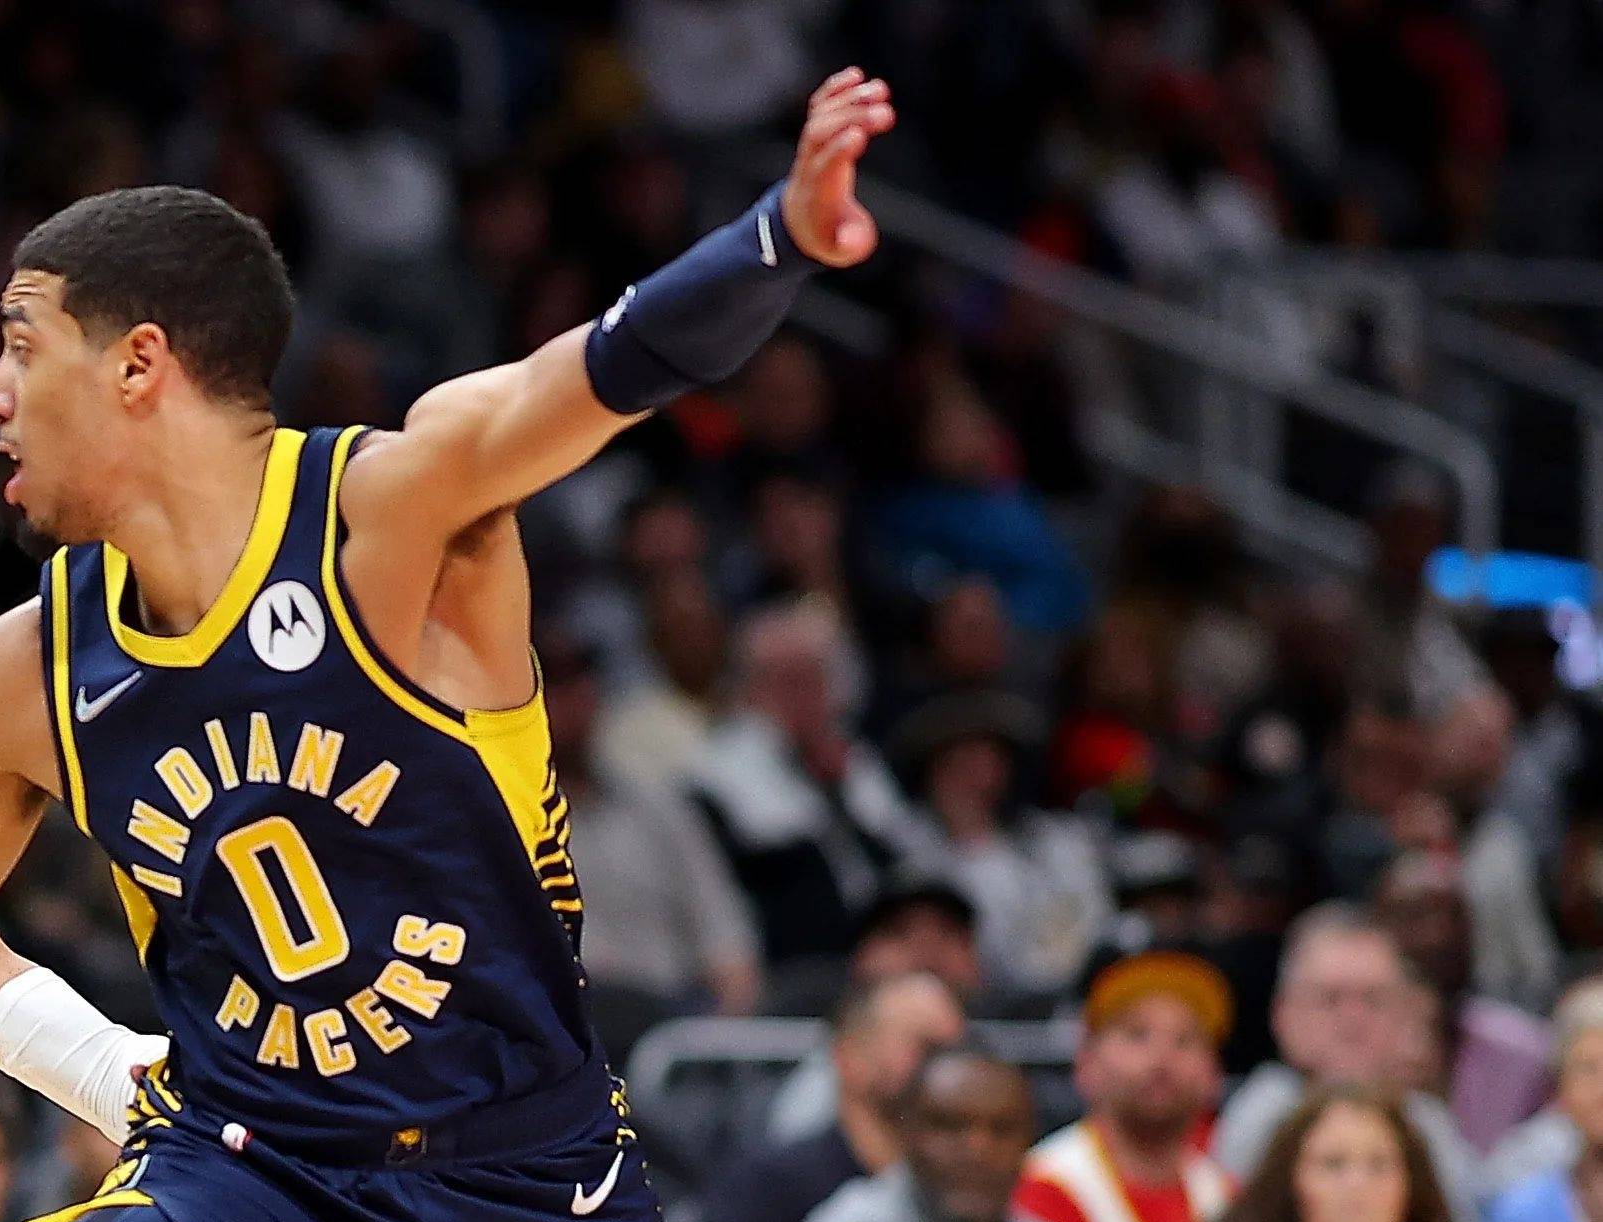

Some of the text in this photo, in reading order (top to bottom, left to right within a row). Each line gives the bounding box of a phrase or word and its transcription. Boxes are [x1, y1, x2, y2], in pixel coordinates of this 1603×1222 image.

[128, 712, 399, 897] INDIANA
[216, 816, 350, 982] 0
[215, 914, 465, 1077] PACERS
